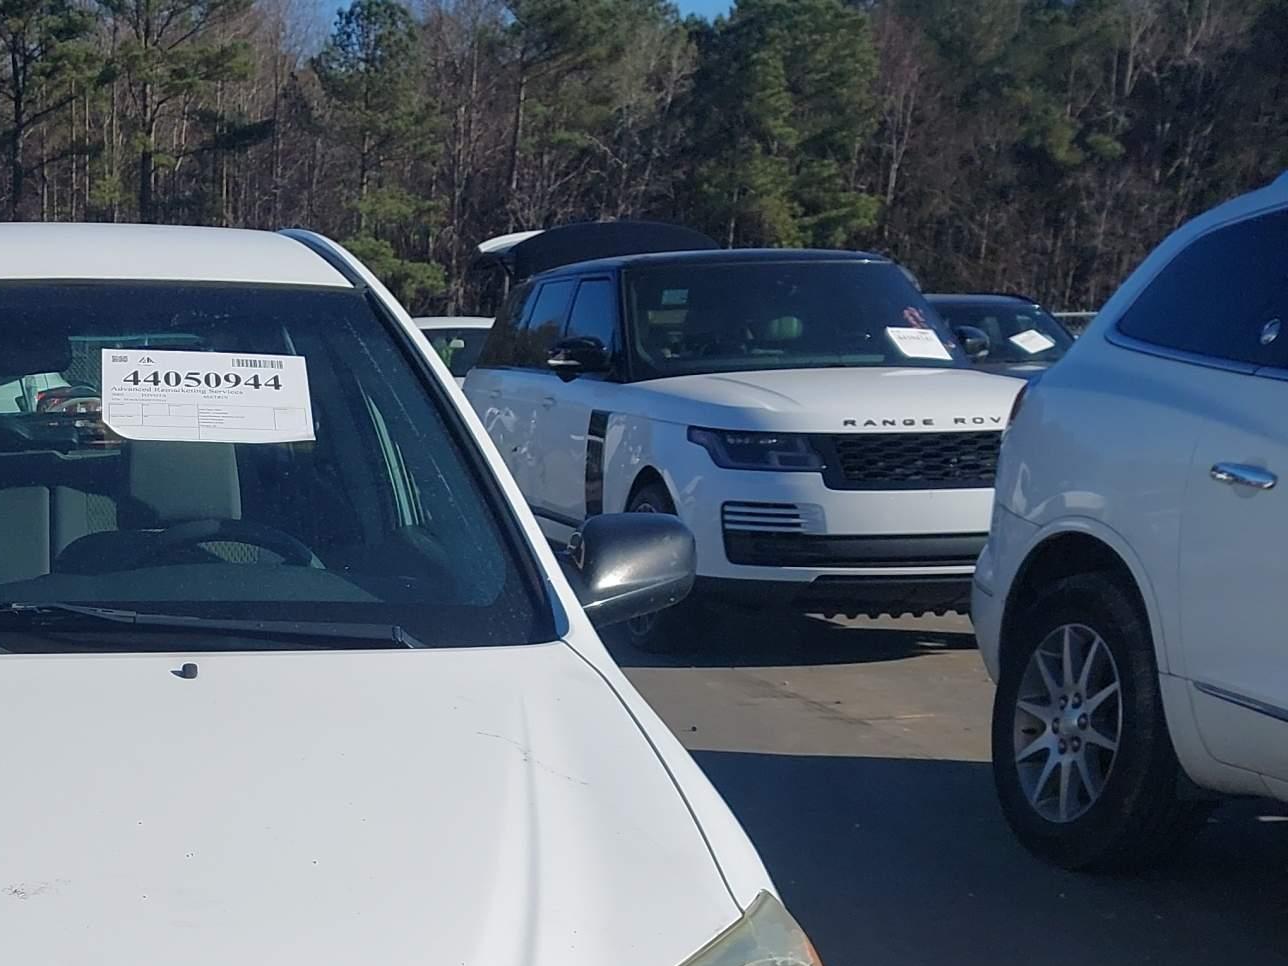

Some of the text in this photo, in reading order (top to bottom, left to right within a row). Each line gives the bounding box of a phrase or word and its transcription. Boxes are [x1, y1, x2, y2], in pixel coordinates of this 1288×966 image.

[123, 370, 283, 390] 44050944
[110, 385, 152, 393] Advanced
[154, 386, 207, 395] Remarketing
[843, 416, 1001, 427] RANGE ROV
